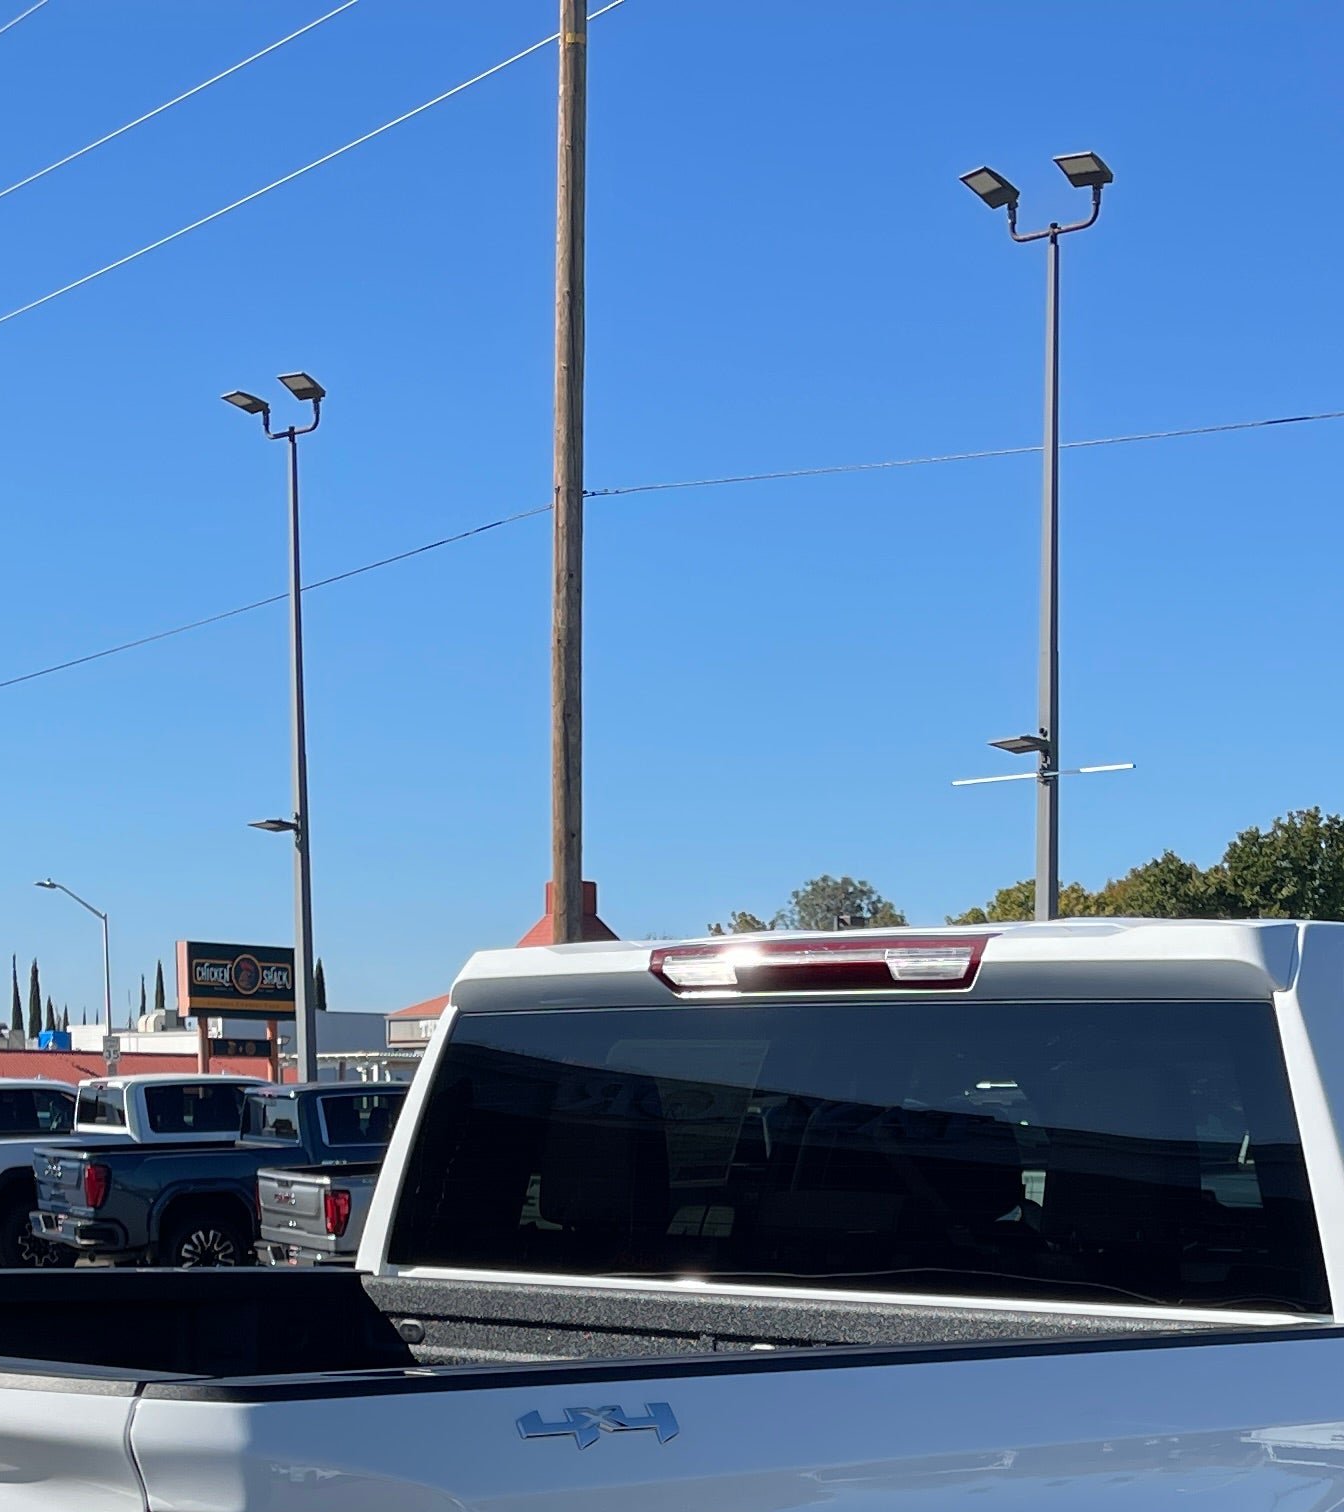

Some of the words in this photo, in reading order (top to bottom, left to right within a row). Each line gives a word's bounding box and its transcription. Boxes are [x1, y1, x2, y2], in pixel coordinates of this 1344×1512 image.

[196, 963, 232, 986] CHICKEN
[263, 967, 292, 989] SHACK
[106, 1049, 119, 1060] 35
